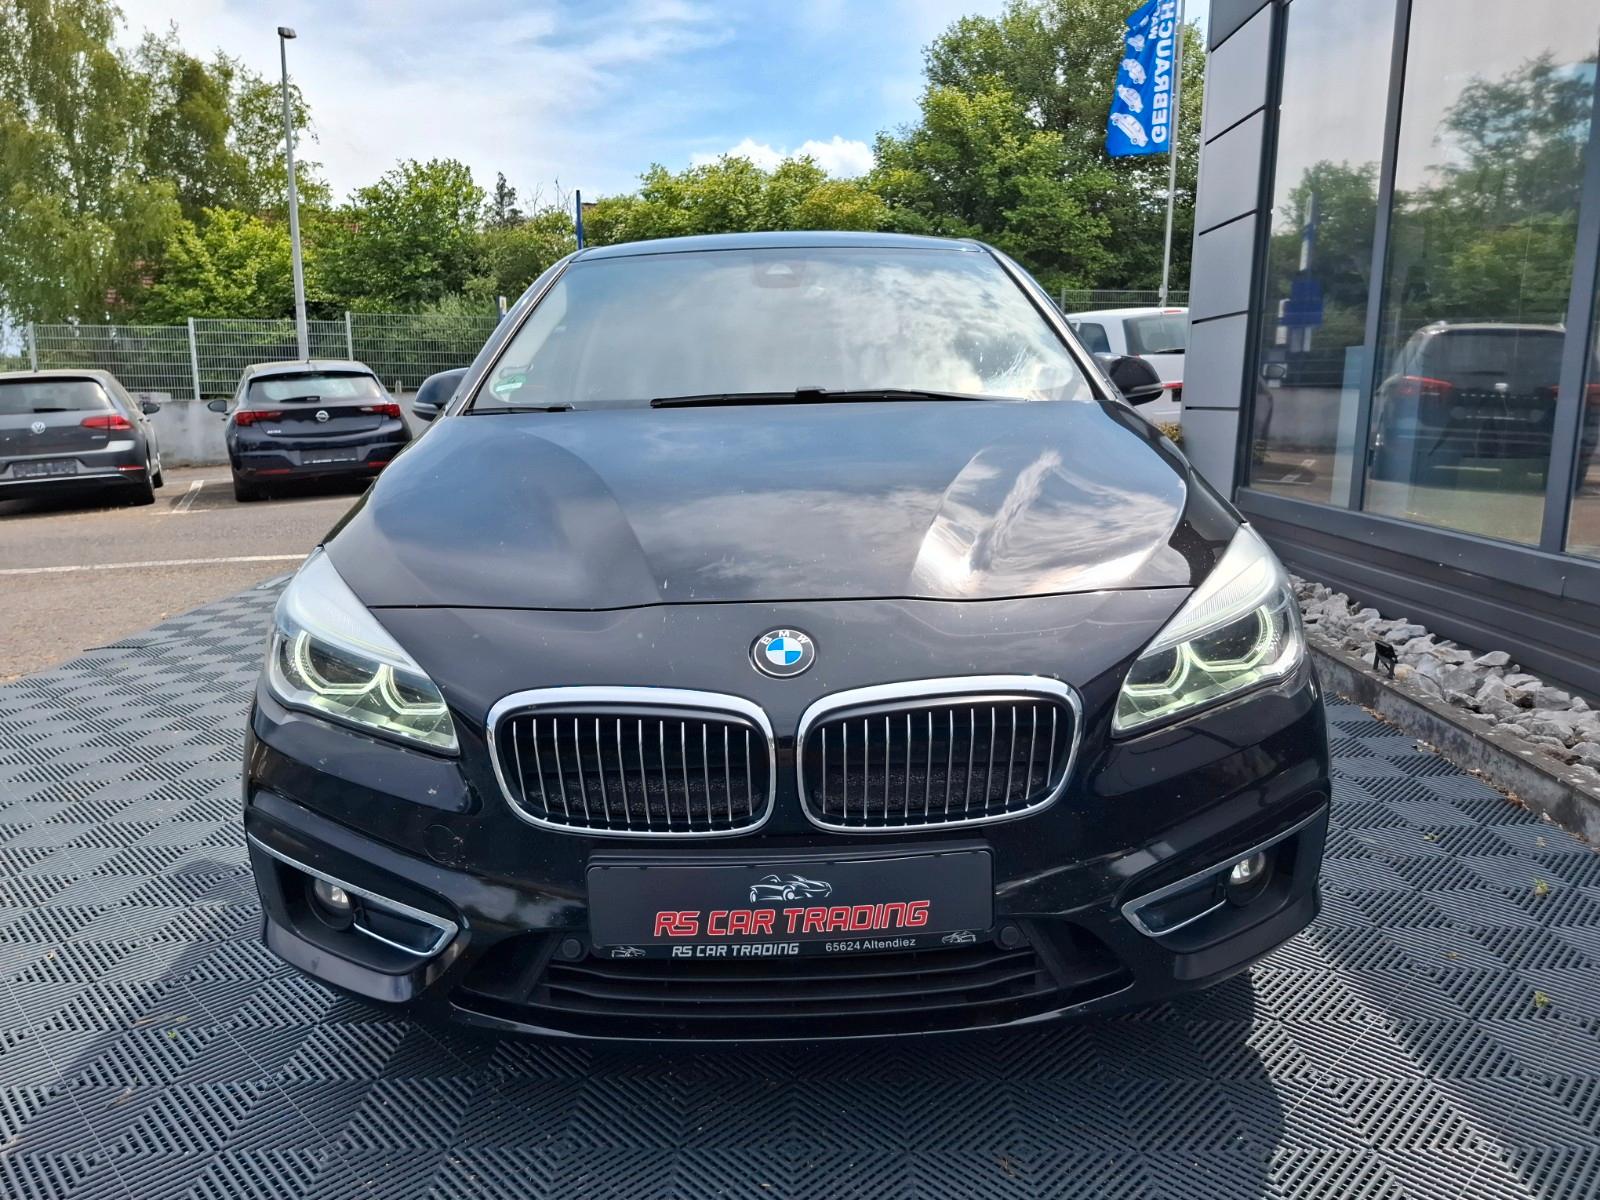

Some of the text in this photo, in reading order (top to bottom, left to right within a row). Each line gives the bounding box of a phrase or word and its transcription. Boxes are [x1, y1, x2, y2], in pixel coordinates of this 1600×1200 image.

[760, 630, 810, 645] BMW
[654, 900, 930, 937] RS CAR TRADING
[672, 943, 799, 957] RS CAR TRADING
[825, 938, 916, 952] 65624 Altendiez
